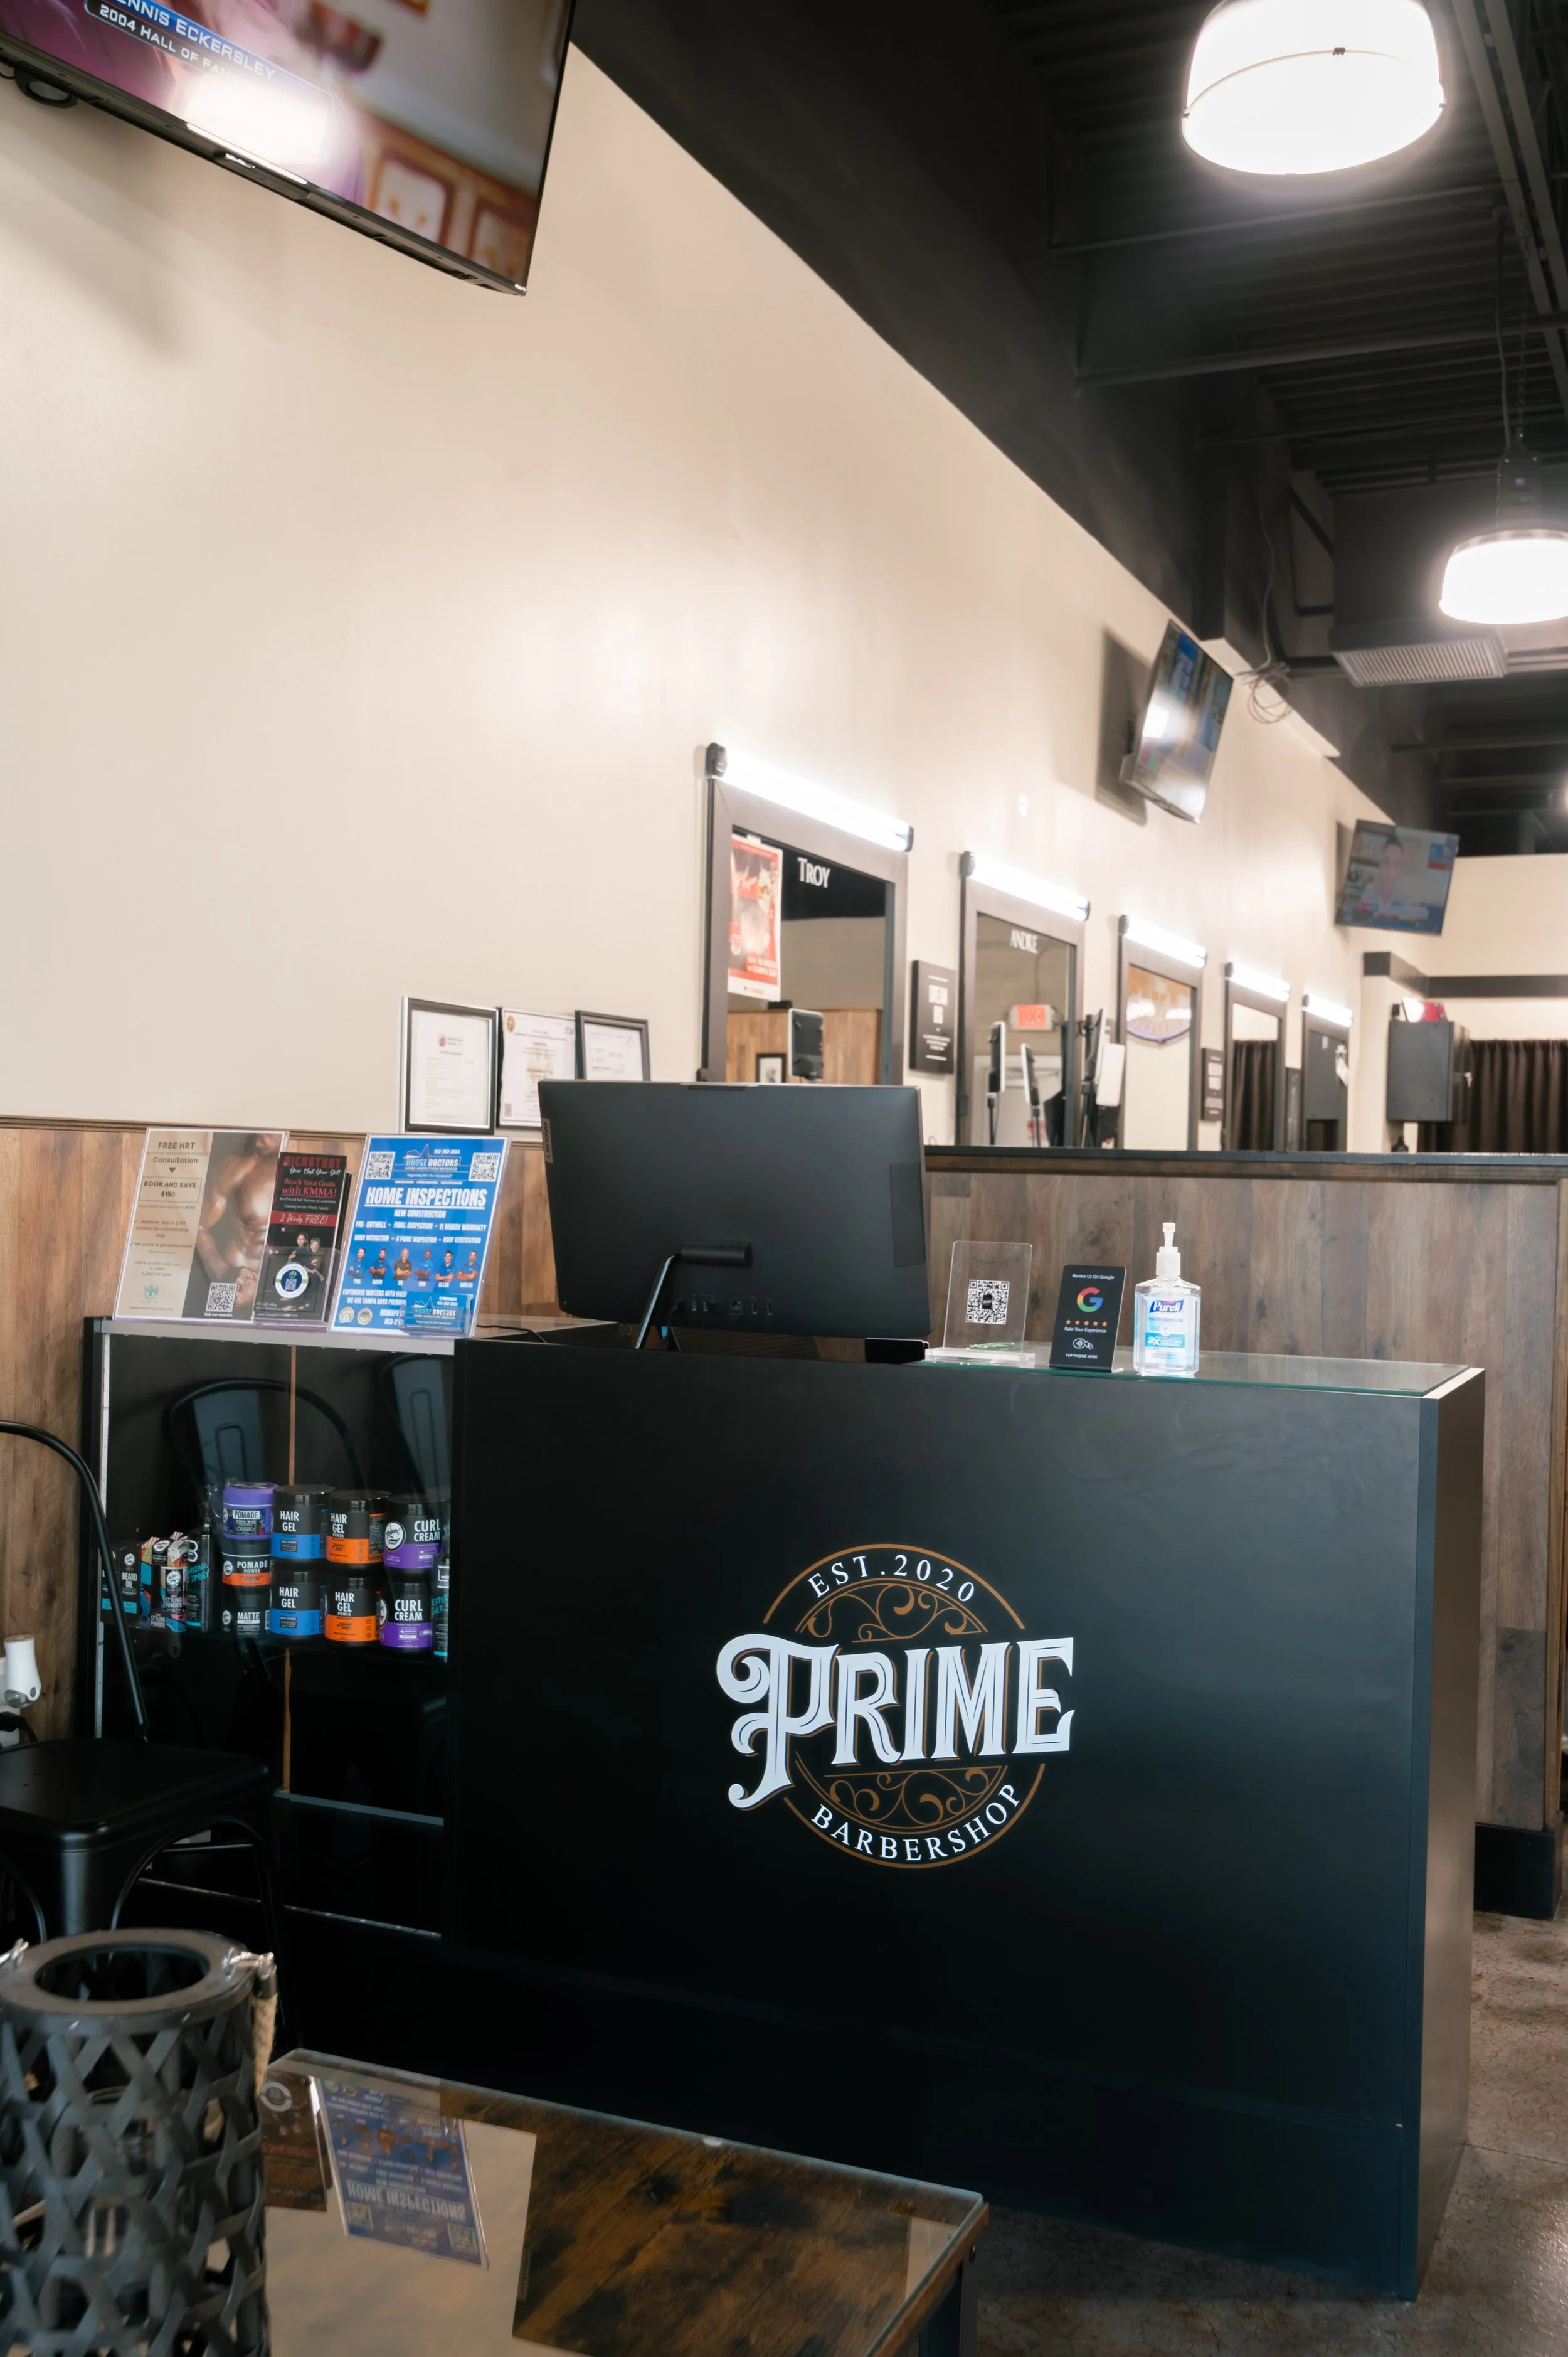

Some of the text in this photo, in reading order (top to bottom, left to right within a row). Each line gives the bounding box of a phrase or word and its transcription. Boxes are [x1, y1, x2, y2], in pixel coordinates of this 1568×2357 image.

[100, 4, 136, 31] 2004
[140, 25, 176, 53] HALL
[181, 48, 199, 61] OF
[176, 18, 275, 81] ECKERSLEY
[797, 857, 831, 888] TROY
[282, 1186, 337, 1196] with KMMA!
[366, 1187, 488, 1207] HOME INSPECTIONS
[280, 1213, 285, 1223] 2
[305, 1215, 328, 1225] FREE!
[393, 1209, 447, 1218] NEW CONSTRUCTION
[406, 1221, 433, 1230] INSPECTION
[461, 1223, 487, 1232] WARRANTY
[1153, 1301, 1180, 1312] Purell
[235, 1511, 258, 1519] POMADE
[280, 1511, 299, 1521] HAIR
[331, 1513, 347, 1524] HAIR
[282, 1522, 297, 1532] GEL
[332, 1523, 345, 1534] GEL
[414, 1519, 440, 1533] CURL
[414, 1531, 441, 1542] CREAM
[237, 1560, 268, 1568] POMADE
[122, 1572, 137, 1581] BEARD
[279, 1587, 299, 1597] HAIR
[335, 1592, 354, 1602] HAIR
[281, 1599, 296, 1608] GEL
[337, 1602, 352, 1612] GEL
[395, 1599, 423, 1612] CURL
[237, 1612, 260, 1620] MATTE
[395, 1612, 423, 1621] CREAM
[716, 1634, 1076, 1809] PRIME
[811, 1784, 1023, 1861] BARBERSHOP
